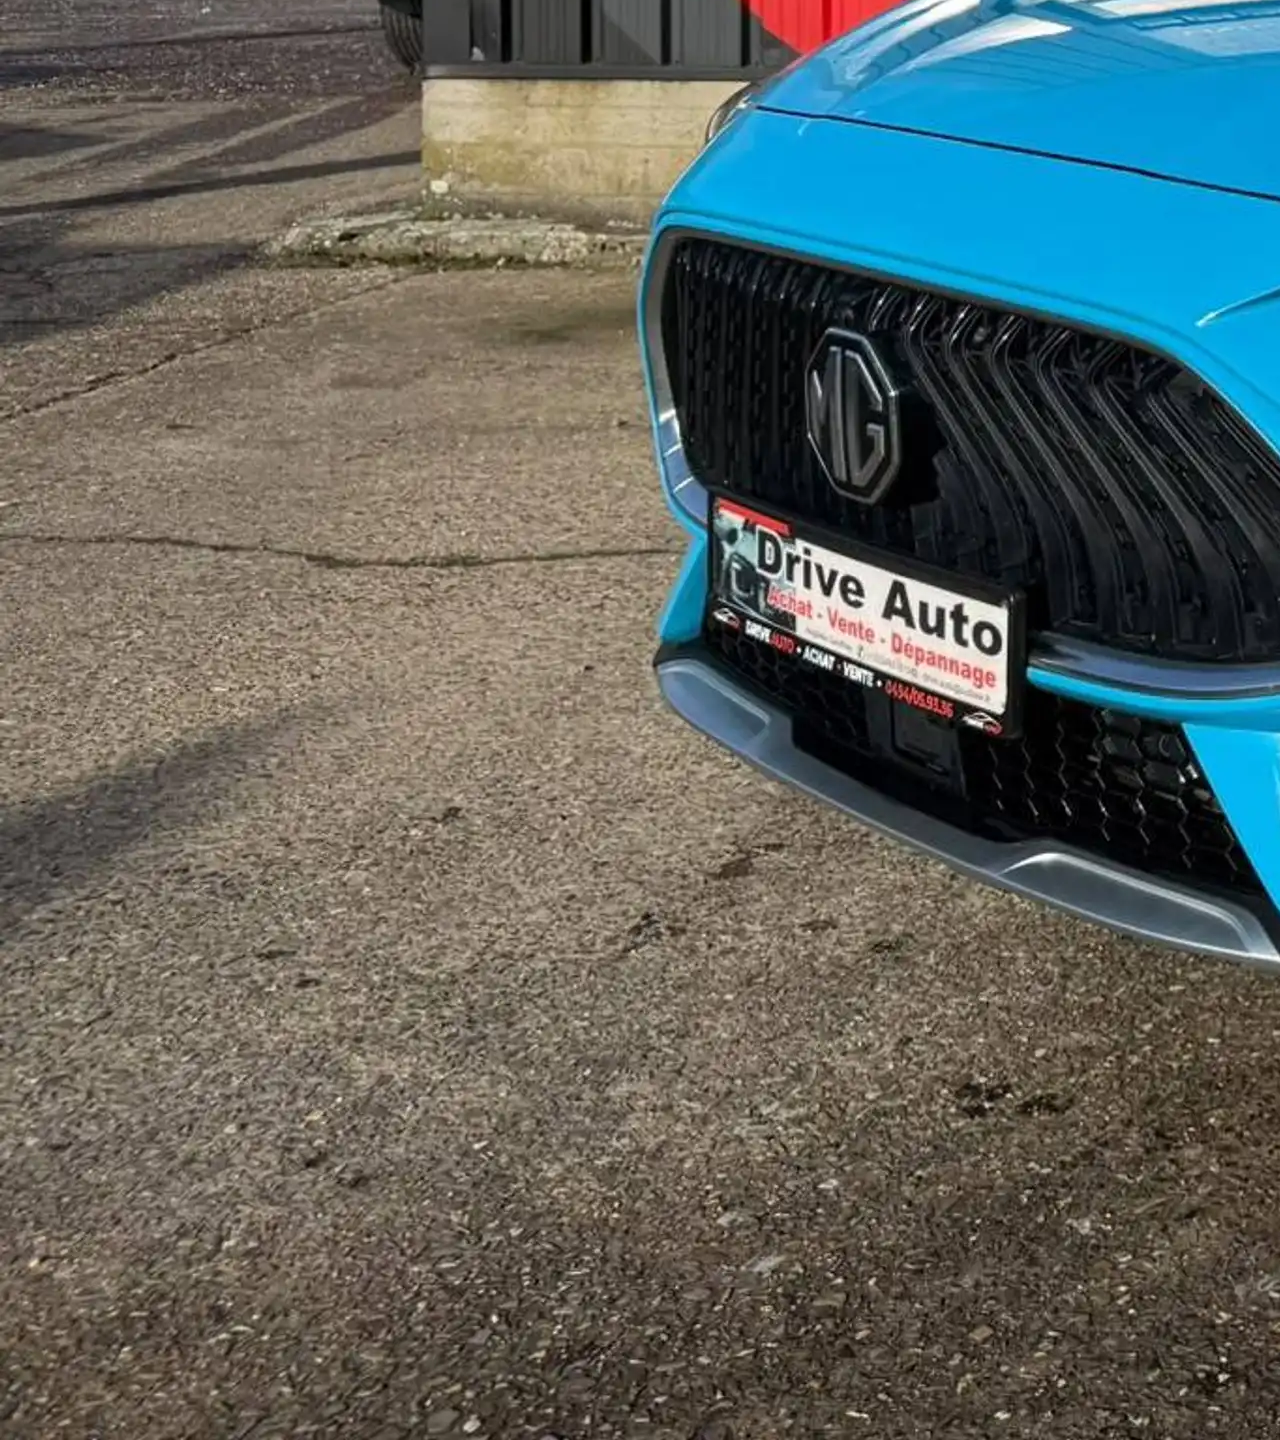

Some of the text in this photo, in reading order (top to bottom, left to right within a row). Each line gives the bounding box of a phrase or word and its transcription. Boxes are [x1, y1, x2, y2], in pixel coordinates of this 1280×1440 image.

[810, 345, 885, 487] MG
[756, 528, 1003, 657] Drive Auto
[767, 584, 814, 620] Achat
[827, 608, 876, 646] Vente
[891, 632, 997, 690] Dépannage
[842, 661, 875, 688] VENTE
